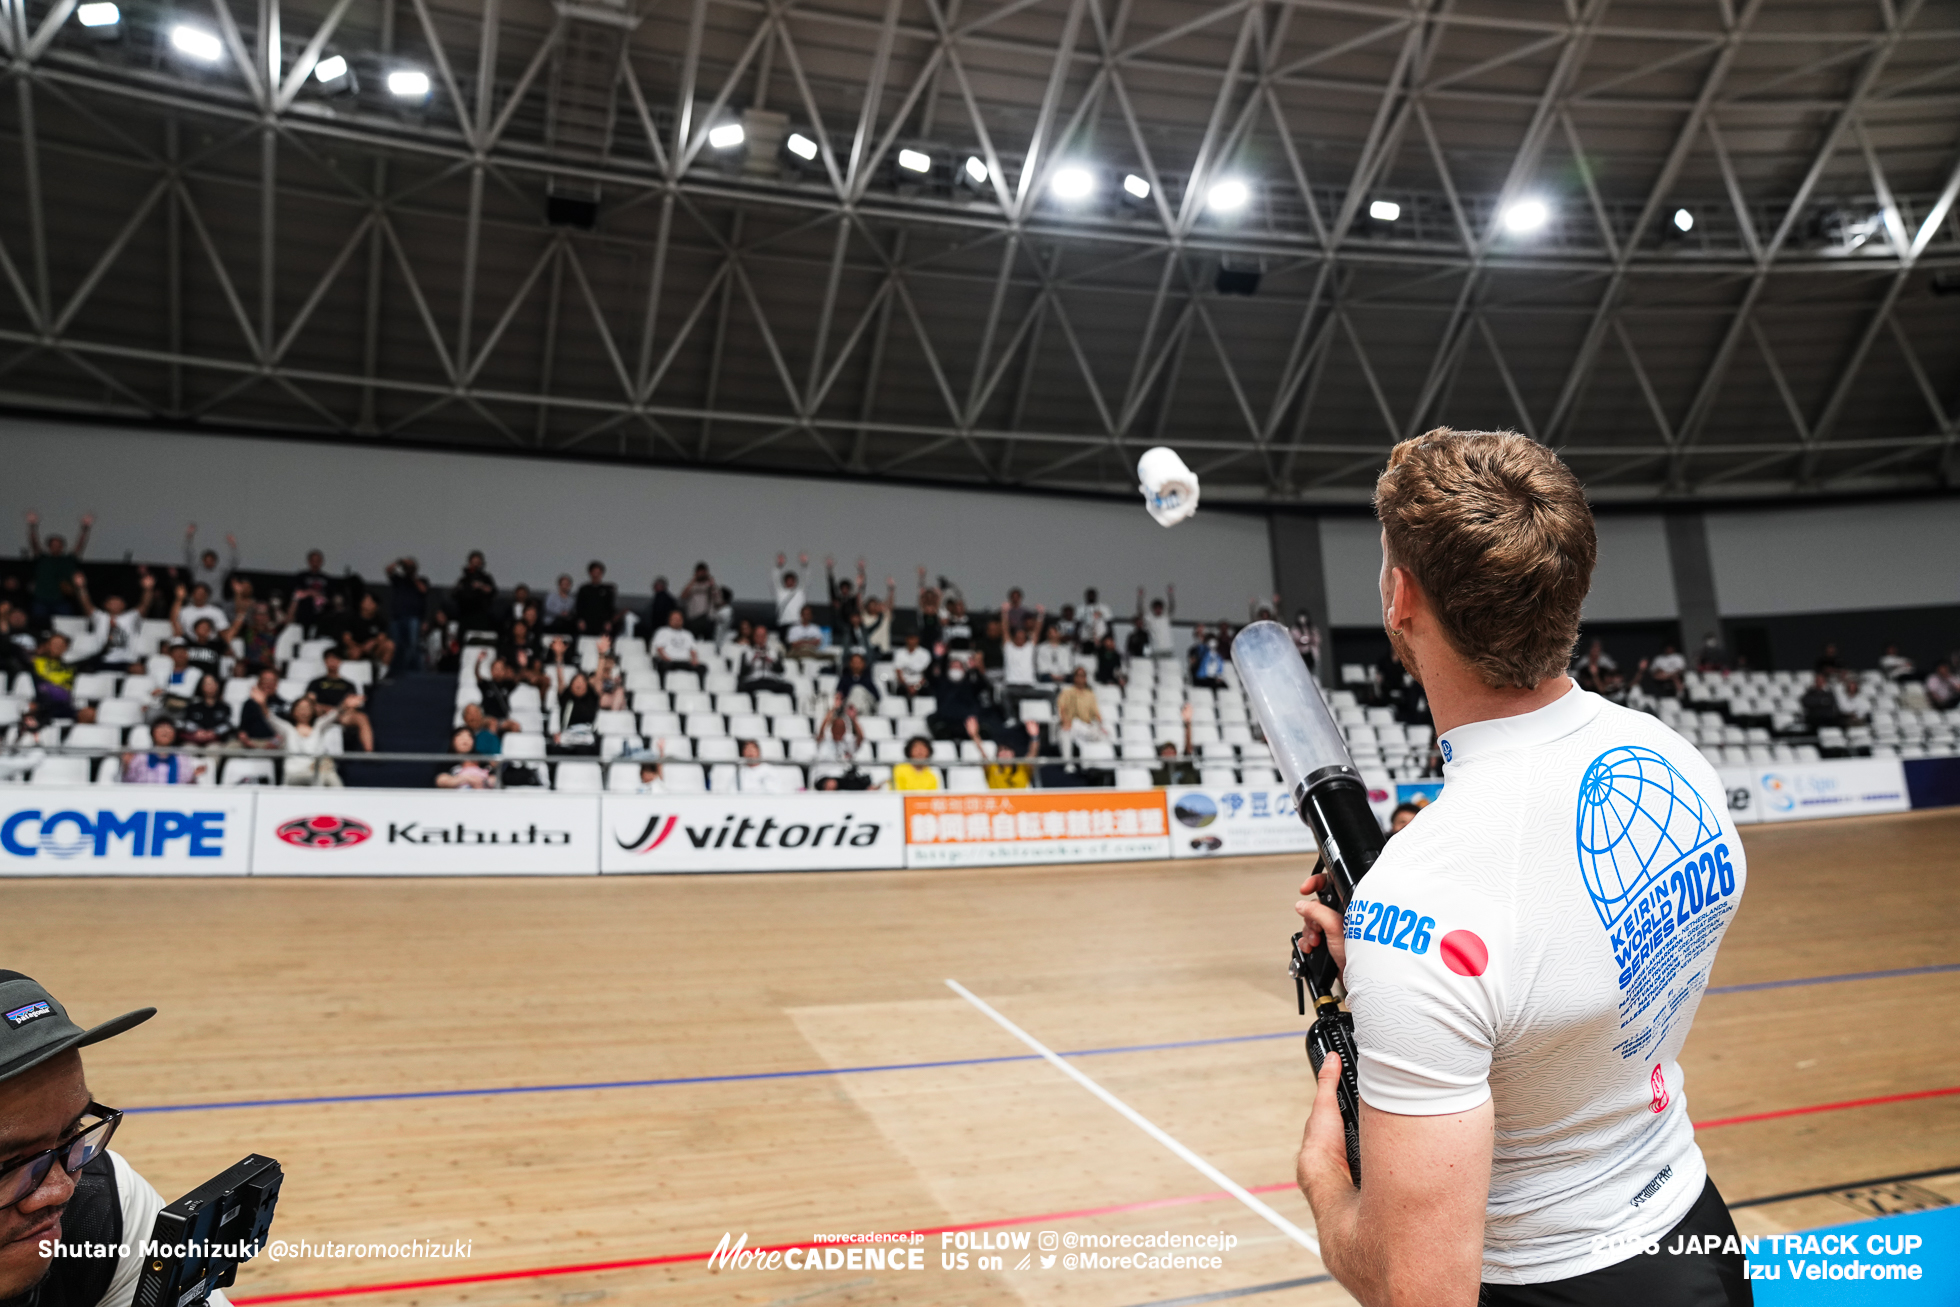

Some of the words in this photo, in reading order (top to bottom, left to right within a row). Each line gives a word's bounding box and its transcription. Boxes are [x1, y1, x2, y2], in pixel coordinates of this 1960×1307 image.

[0, 810, 226, 859] COMPE
[684, 813, 880, 849] vittoria
[1610, 880, 1669, 953] KEIRIN
[1669, 843, 1735, 927] 2026
[1363, 901, 1436, 955] 2026
[1614, 900, 1672, 969] WORLD
[1619, 918, 1675, 990] SERIES
